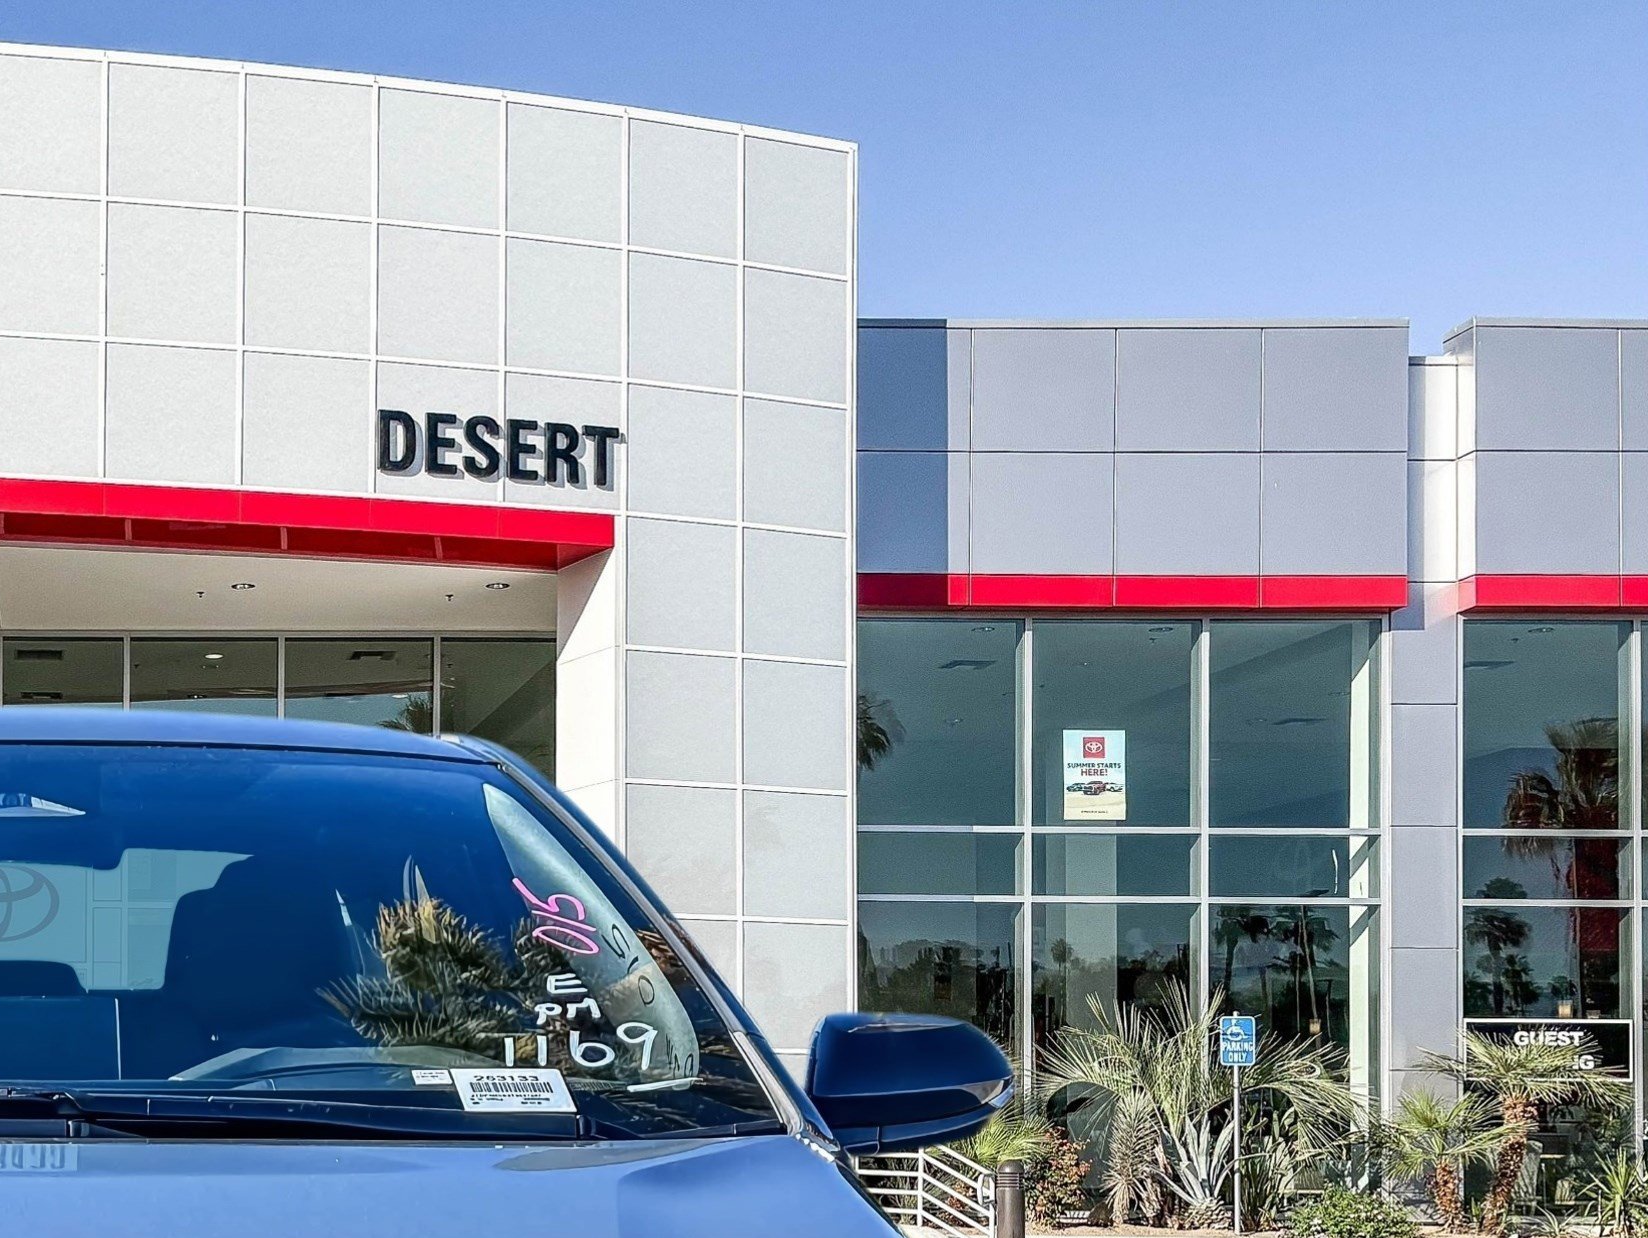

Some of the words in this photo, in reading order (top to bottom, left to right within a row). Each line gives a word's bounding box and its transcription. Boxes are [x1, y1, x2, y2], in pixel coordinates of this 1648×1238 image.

[377, 409, 620, 487] DESERT
[1080, 768, 1108, 776] HERE!
[1513, 1030, 1584, 1047] GUEST
[1221, 1040, 1254, 1051] PARKING
[1228, 1051, 1247, 1062] ONLY
